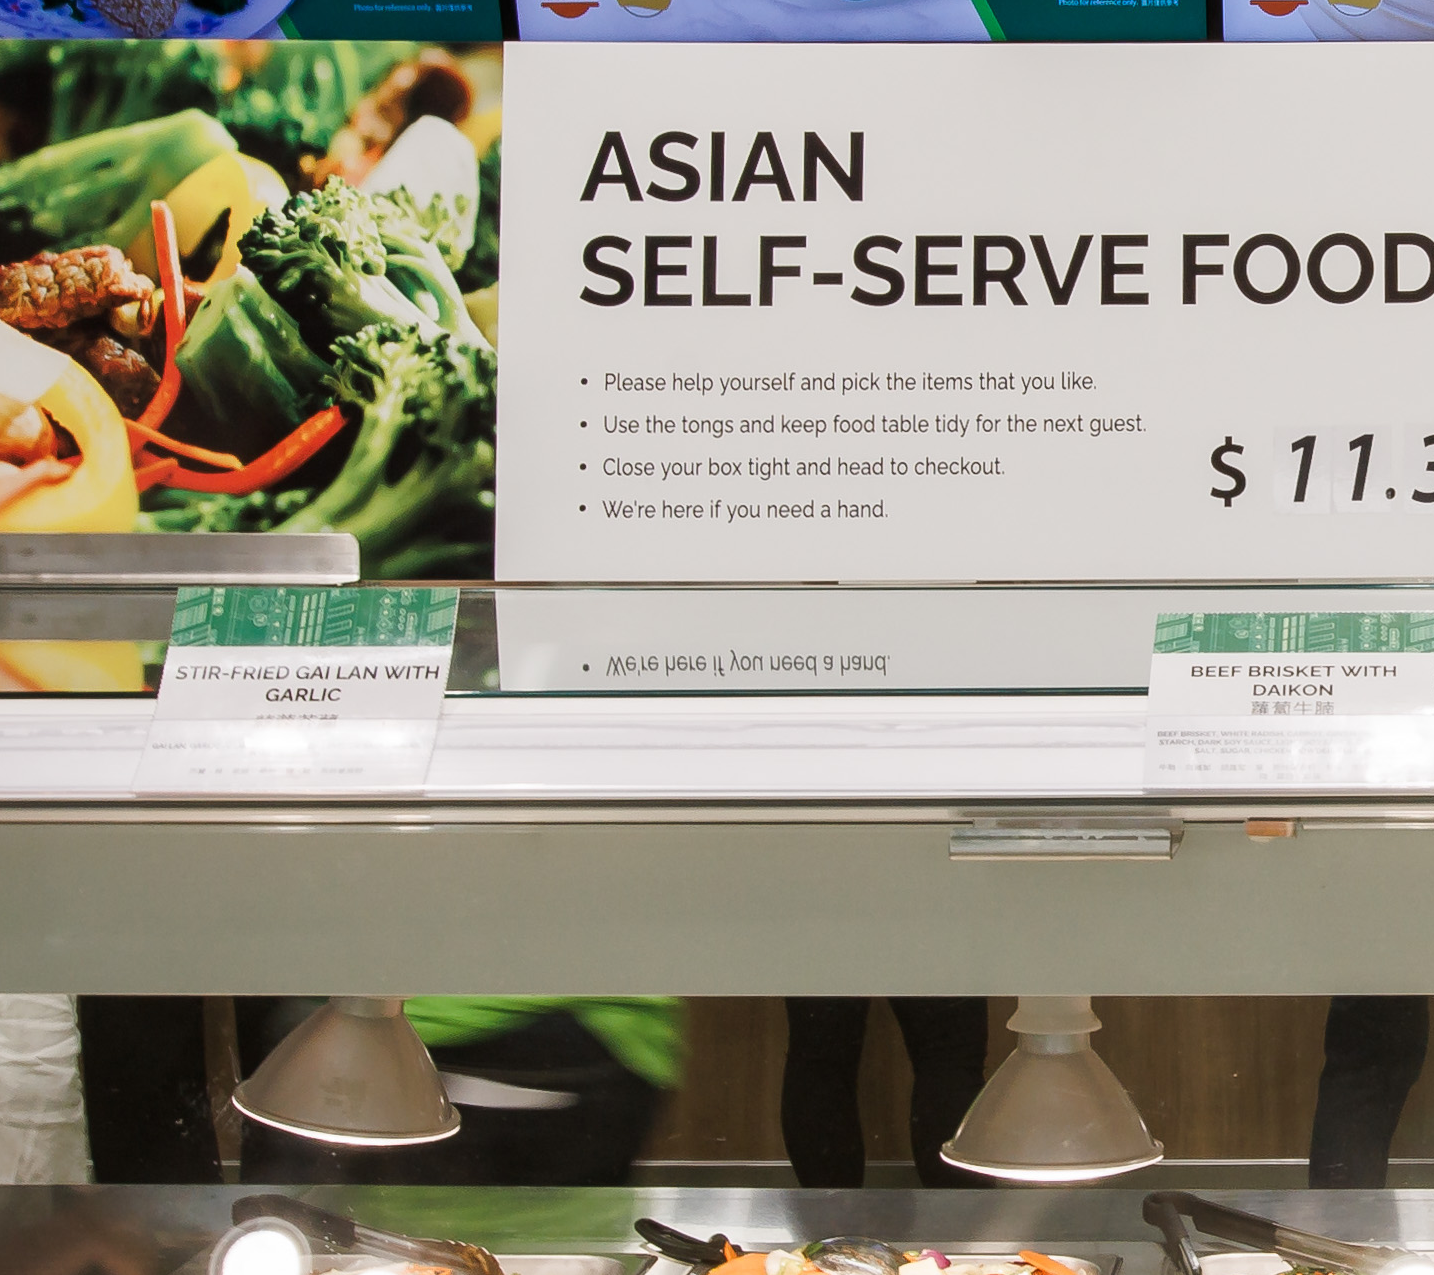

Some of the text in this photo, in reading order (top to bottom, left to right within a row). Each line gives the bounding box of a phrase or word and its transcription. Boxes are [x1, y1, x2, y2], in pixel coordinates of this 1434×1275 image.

[580, 131, 864, 202] ASIAN
[579, 233, 1149, 307] SELF-SERVE
[606, 372, 1097, 395] Please help yourself and pick the items that you like.
[605, 414, 1146, 438] Use the tongs and keep food table tidy for the next guest.
[604, 457, 1005, 480] Close your box tight and head to checkout.
[1210, 436, 1246, 508] $
[603, 500, 888, 523] We're here if you need a hand.
[175, 665, 441, 680] STIR-FRIED GAI LAN WITH
[1191, 665, 1397, 677] BEEF BRISKET WITH
[265, 687, 342, 702] GARLIC
[1253, 684, 1334, 696] DAIKON
